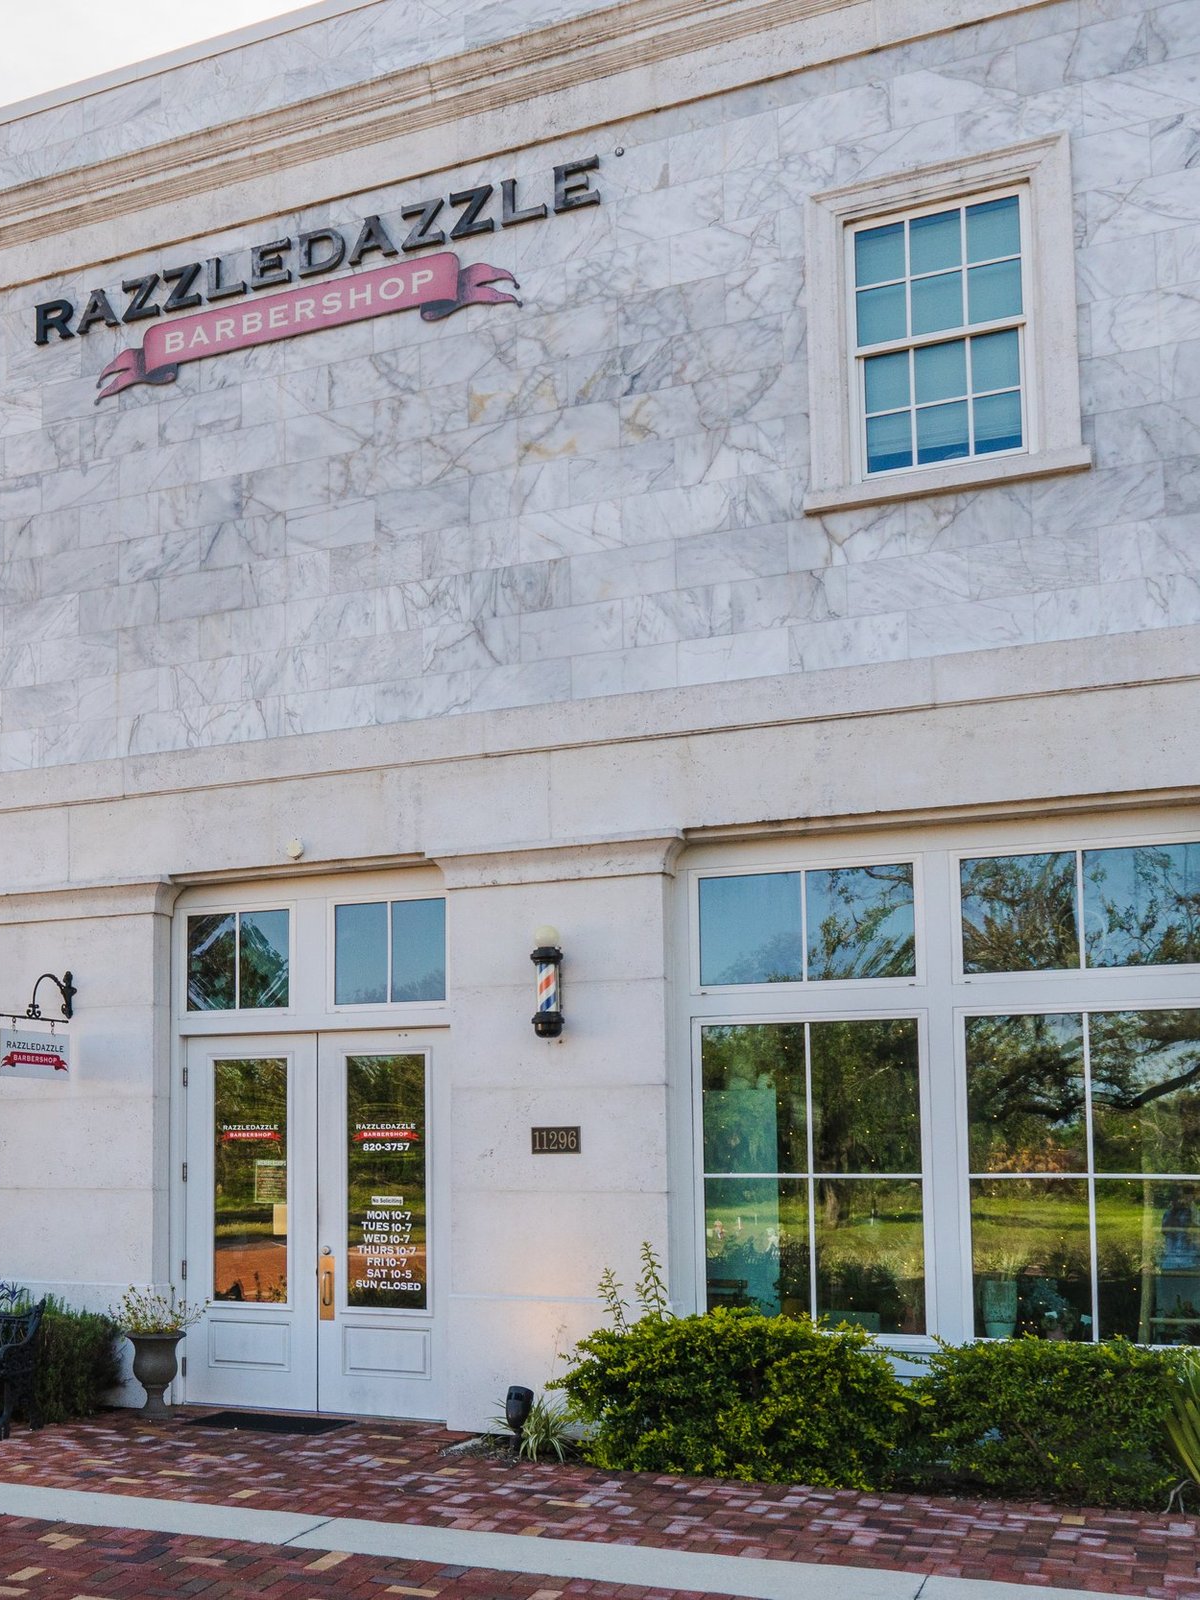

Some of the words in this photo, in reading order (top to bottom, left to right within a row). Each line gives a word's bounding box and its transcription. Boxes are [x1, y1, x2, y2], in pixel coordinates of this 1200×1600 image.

[33, 153, 601, 346] RAZZLEDAZZLE
[164, 268, 436, 355] BARBERSHOP
[6, 1040, 64, 1053] RAZZLEDAZZLE
[13, 1054, 58, 1063] BARBERSHOP
[533, 1130, 577, 1150] 11296
[362, 1142, 410, 1151] 820-3757
[366, 1210, 390, 1220] MON
[391, 1211, 412, 1221] 10-7
[361, 1221, 390, 1231] TUES
[391, 1223, 412, 1232] 10-7
[363, 1233, 388, 1243] WED
[389, 1234, 410, 1244] 10-7
[357, 1245, 395, 1255] THURS
[396, 1246, 416, 1255] 10-7
[366, 1257, 385, 1266] FRI
[385, 1258, 407, 1267] 10-7
[366, 1268, 388, 1278] SAT
[390, 1270, 412, 1279] 10-5
[355, 1279, 378, 1288] SUN
[379, 1280, 421, 1291] CLOSED
